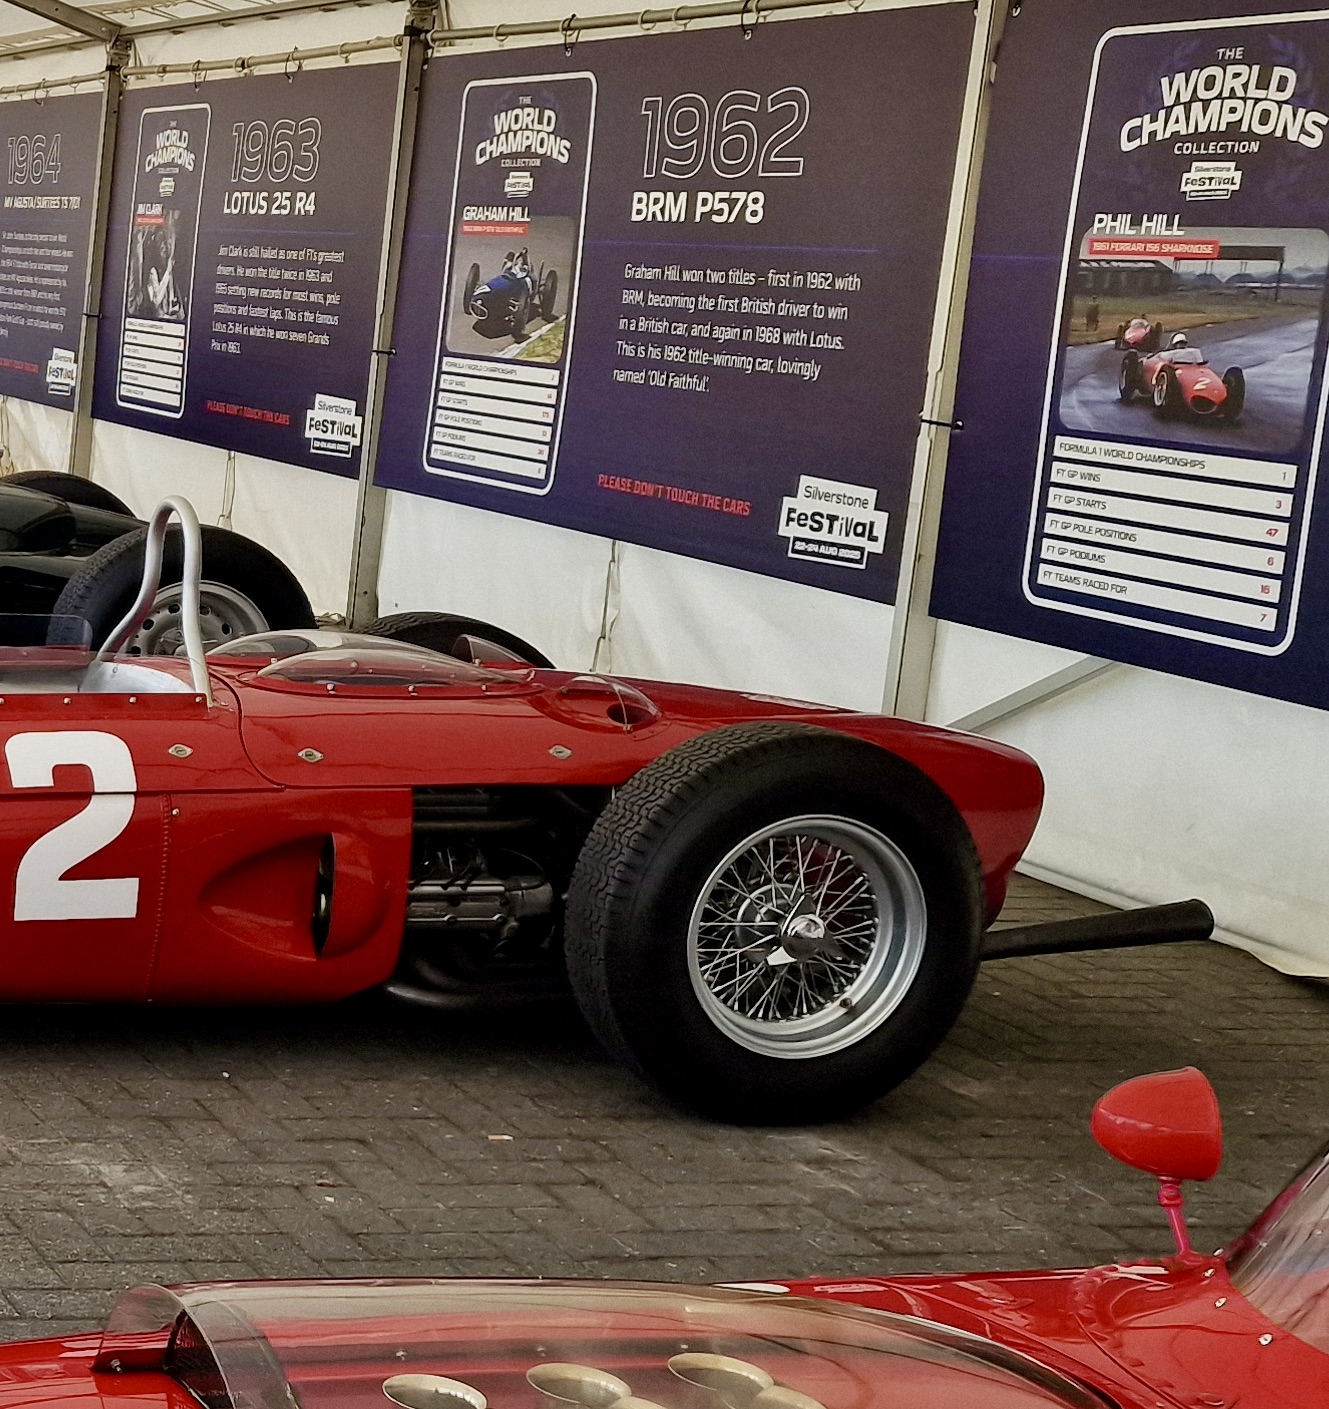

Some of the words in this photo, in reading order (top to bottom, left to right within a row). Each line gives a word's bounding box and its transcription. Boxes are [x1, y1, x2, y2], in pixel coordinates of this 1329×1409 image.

[1216, 47, 1244, 60] THE
[1160, 64, 1297, 107] WORLD
[493, 107, 557, 135] WORLD
[641, 86, 810, 179] 1962
[1120, 99, 1329, 152] CHAMPIONS
[156, 129, 189, 149] WORLD
[231, 117, 322, 183] 1963
[475, 130, 572, 165] CHAMPIONS
[1174, 141, 1260, 154] COLLECTION
[7, 133, 62, 185] 1964
[145, 146, 196, 172] CHAMPIONS
[223, 191, 268, 215] LOTUS
[272, 192, 291, 216] 25
[294, 192, 317, 216] R4
[463, 206, 507, 221] GRAHAM
[508, 207, 531, 221] HILL
[631, 191, 688, 222] BRM
[694, 191, 765, 224] P578
[1092, 213, 1137, 234] PHIL
[1140, 214, 1185, 236] HILL
[624, 263, 662, 280] Graham
[664, 265, 680, 281] Hill
[682, 269, 703, 283] won
[706, 268, 725, 283] two
[728, 267, 756, 285] titles
[768, 269, 790, 287] first
[792, 271, 804, 288] in
[807, 271, 832, 289] 1962
[835, 273, 861, 291] with
[622, 289, 645, 307] BRM,
[647, 290, 695, 313] becoming
[698, 294, 715, 311] the
[717, 295, 739, 313] first
[741, 297, 775, 315] British
[778, 298, 811, 317] driver
[813, 302, 824, 318] to
[828, 303, 848, 320] win
[619, 314, 628, 330] in
[629, 319, 636, 331] a
[638, 317, 669, 334] British
[671, 322, 688, 337] car,
[691, 321, 711, 337] and
[712, 324, 740, 343] again
[742, 325, 753, 341] in
[755, 326, 781, 344] 1968
[783, 329, 807, 346] with
[810, 330, 845, 350] Lotus.
[613, 368, 645, 384] named
[617, 340, 636, 356] This
[637, 342, 646, 358] is
[647, 343, 661, 360] his
[664, 345, 686, 362] 1962
[688, 347, 753, 374] title-winning
[755, 357, 774, 374] car,
[777, 356, 821, 381] lovingly
[1193, 377, 1210, 391] 2
[317, 401, 353, 416] Silverstone
[1060, 442, 1097, 455] FORMULA
[1104, 448, 1134, 460] WORLD
[1136, 452, 1206, 469] CHAMPIONSHIPS
[1282, 472, 1287, 481] 1
[598, 474, 632, 492] PLEASE
[634, 481, 665, 499] DON'T
[666, 487, 698, 505] TOUCH
[702, 494, 721, 511] THE
[723, 498, 752, 516] CARS
[803, 485, 869, 509] Silverstone
[1056, 468, 1066, 477] FT
[1067, 470, 1078, 479] GP
[1080, 472, 1101, 482] WINS
[1275, 500, 1282, 510] 3
[1050, 520, 1059, 529] FT
[1061, 521, 1072, 530] GP
[1073, 524, 1093, 535] POLE
[1095, 527, 1138, 542] POSITIONS
[1053, 494, 1063, 503] FT
[1064, 496, 1076, 504] GP
[1077, 497, 1107, 510] STARTS
[1265, 528, 1279, 537] 47
[1047, 545, 1056, 554] FT
[1057, 547, 1069, 556] GP
[1070, 549, 1106, 563] PODIUMS
[1043, 571, 1053, 580] FT
[1055, 573, 1081, 586] TEAMS
[1083, 579, 1109, 591] RACED
[1110, 584, 1128, 595] FOR
[1260, 614, 1267, 623] 7
[4, 730, 139, 921] 2
